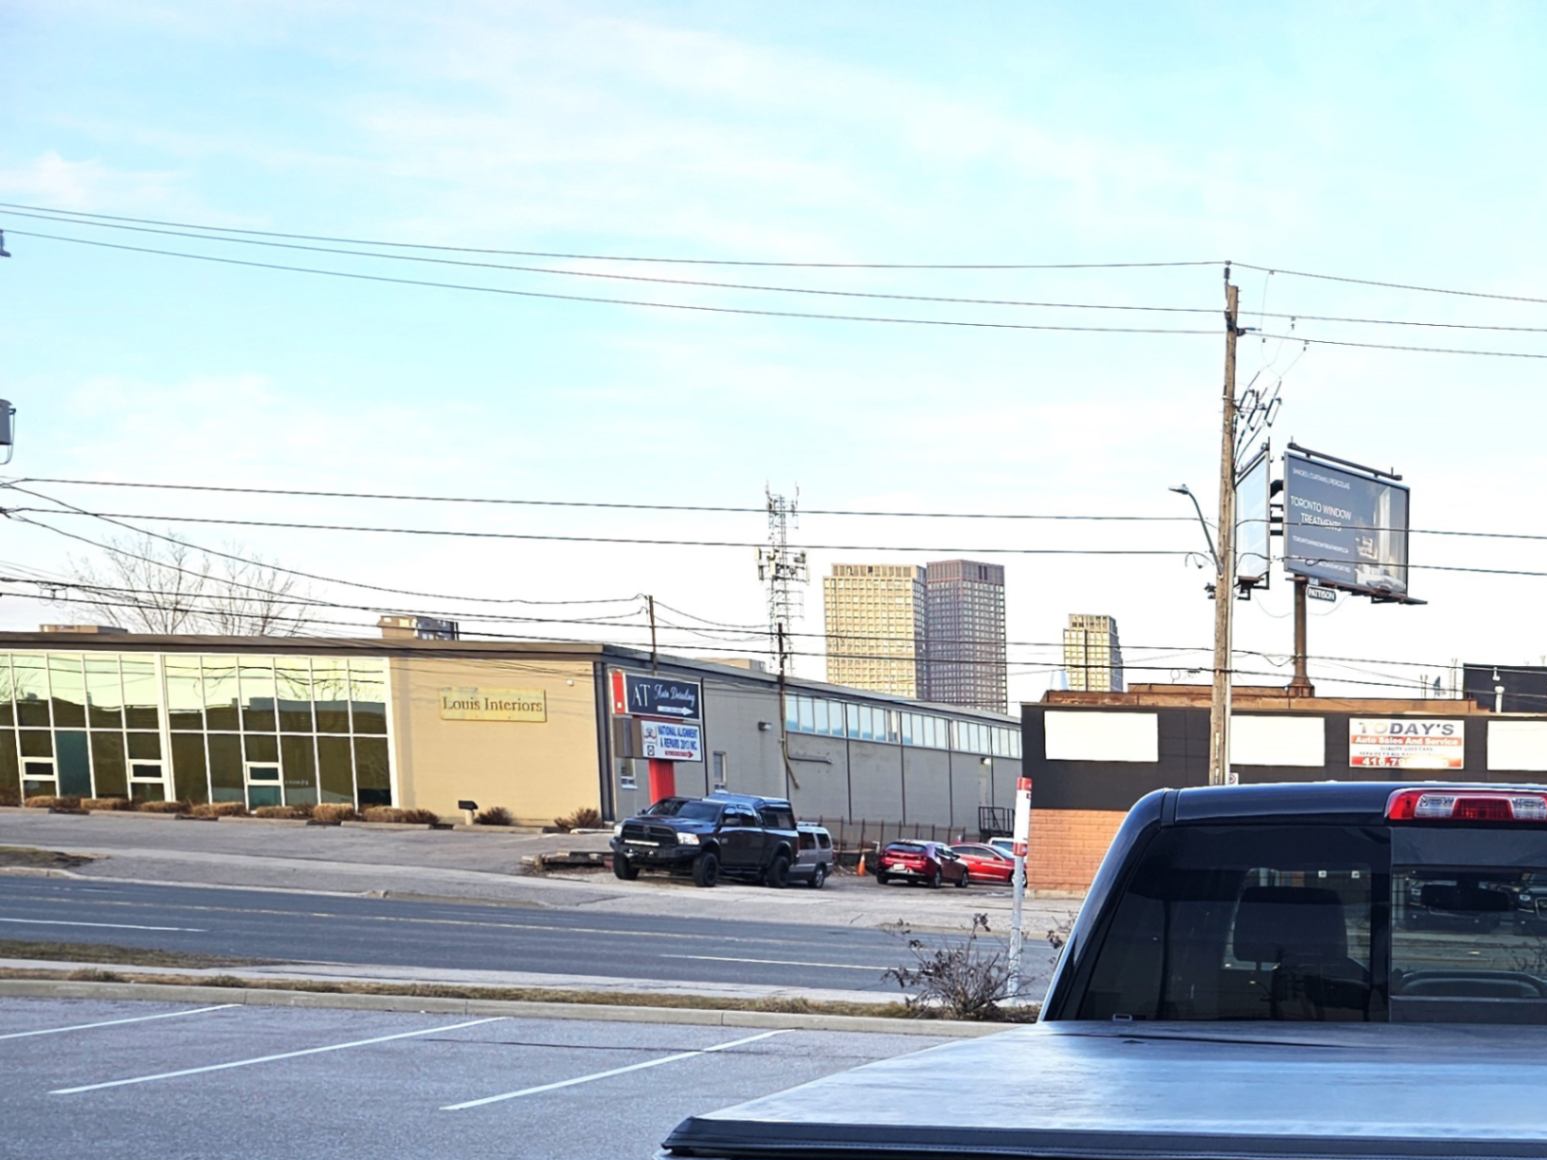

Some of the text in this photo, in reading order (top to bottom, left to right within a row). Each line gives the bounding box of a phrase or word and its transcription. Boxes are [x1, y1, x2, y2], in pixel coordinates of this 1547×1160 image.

[1290, 495, 1352, 521] TORONTO WINDOW
[1307, 588, 1335, 600] PATTISON
[632, 683, 651, 707] AT
[443, 696, 543, 712] Louis Interiors
[1358, 722, 1455, 736] TODAY'S
[1354, 736, 1377, 744] Auto
[1379, 736, 1404, 745] Sales
[1405, 736, 1424, 745] And
